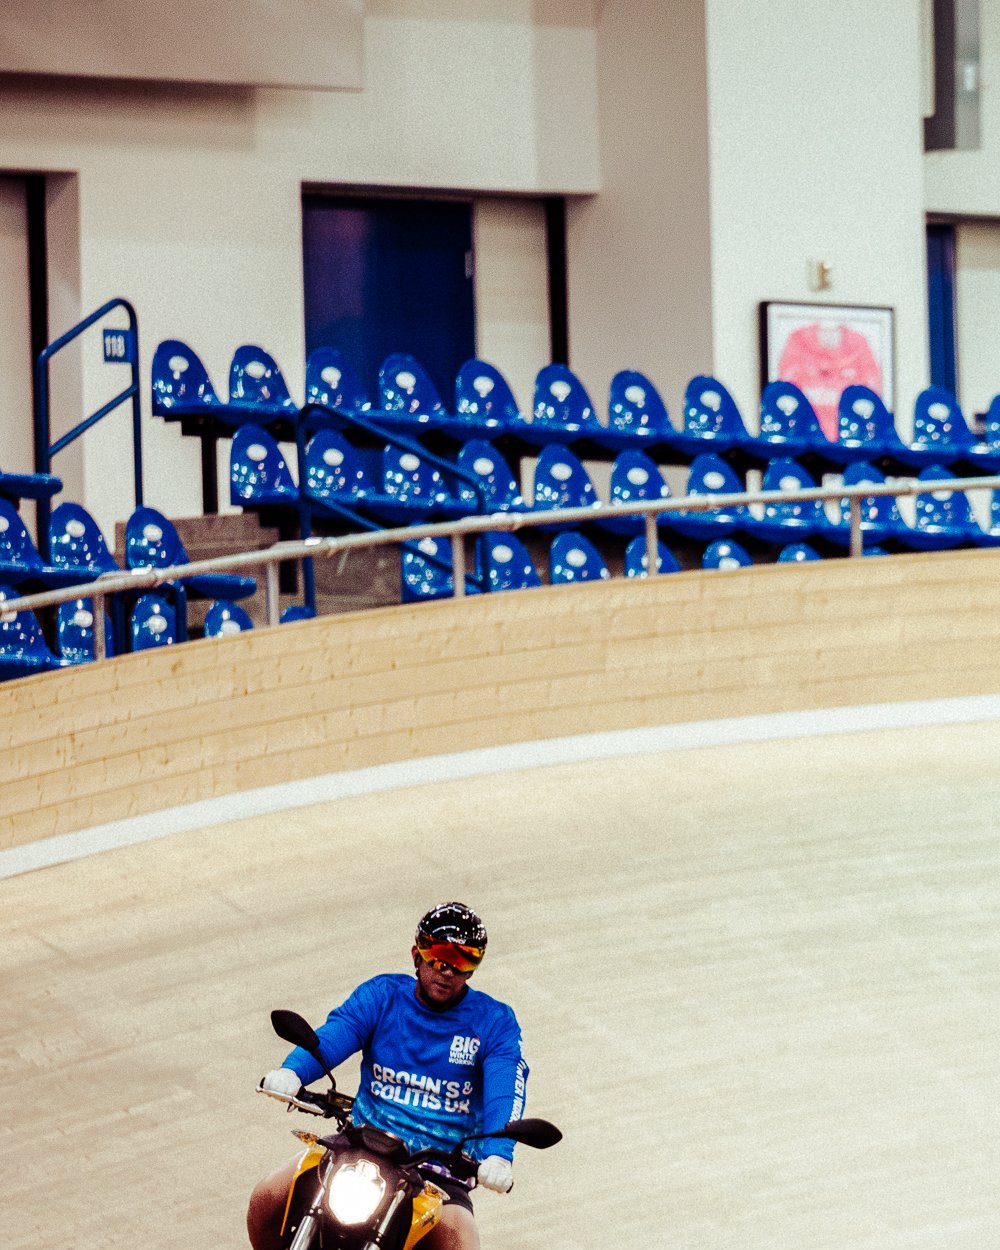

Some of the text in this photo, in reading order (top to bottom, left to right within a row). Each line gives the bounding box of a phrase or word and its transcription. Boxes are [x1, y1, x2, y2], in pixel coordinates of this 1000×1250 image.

[450, 1035, 480, 1055] BIG
[373, 1063, 473, 1098] CROHN'S &
[371, 1081, 470, 1114] COLITIS UK
